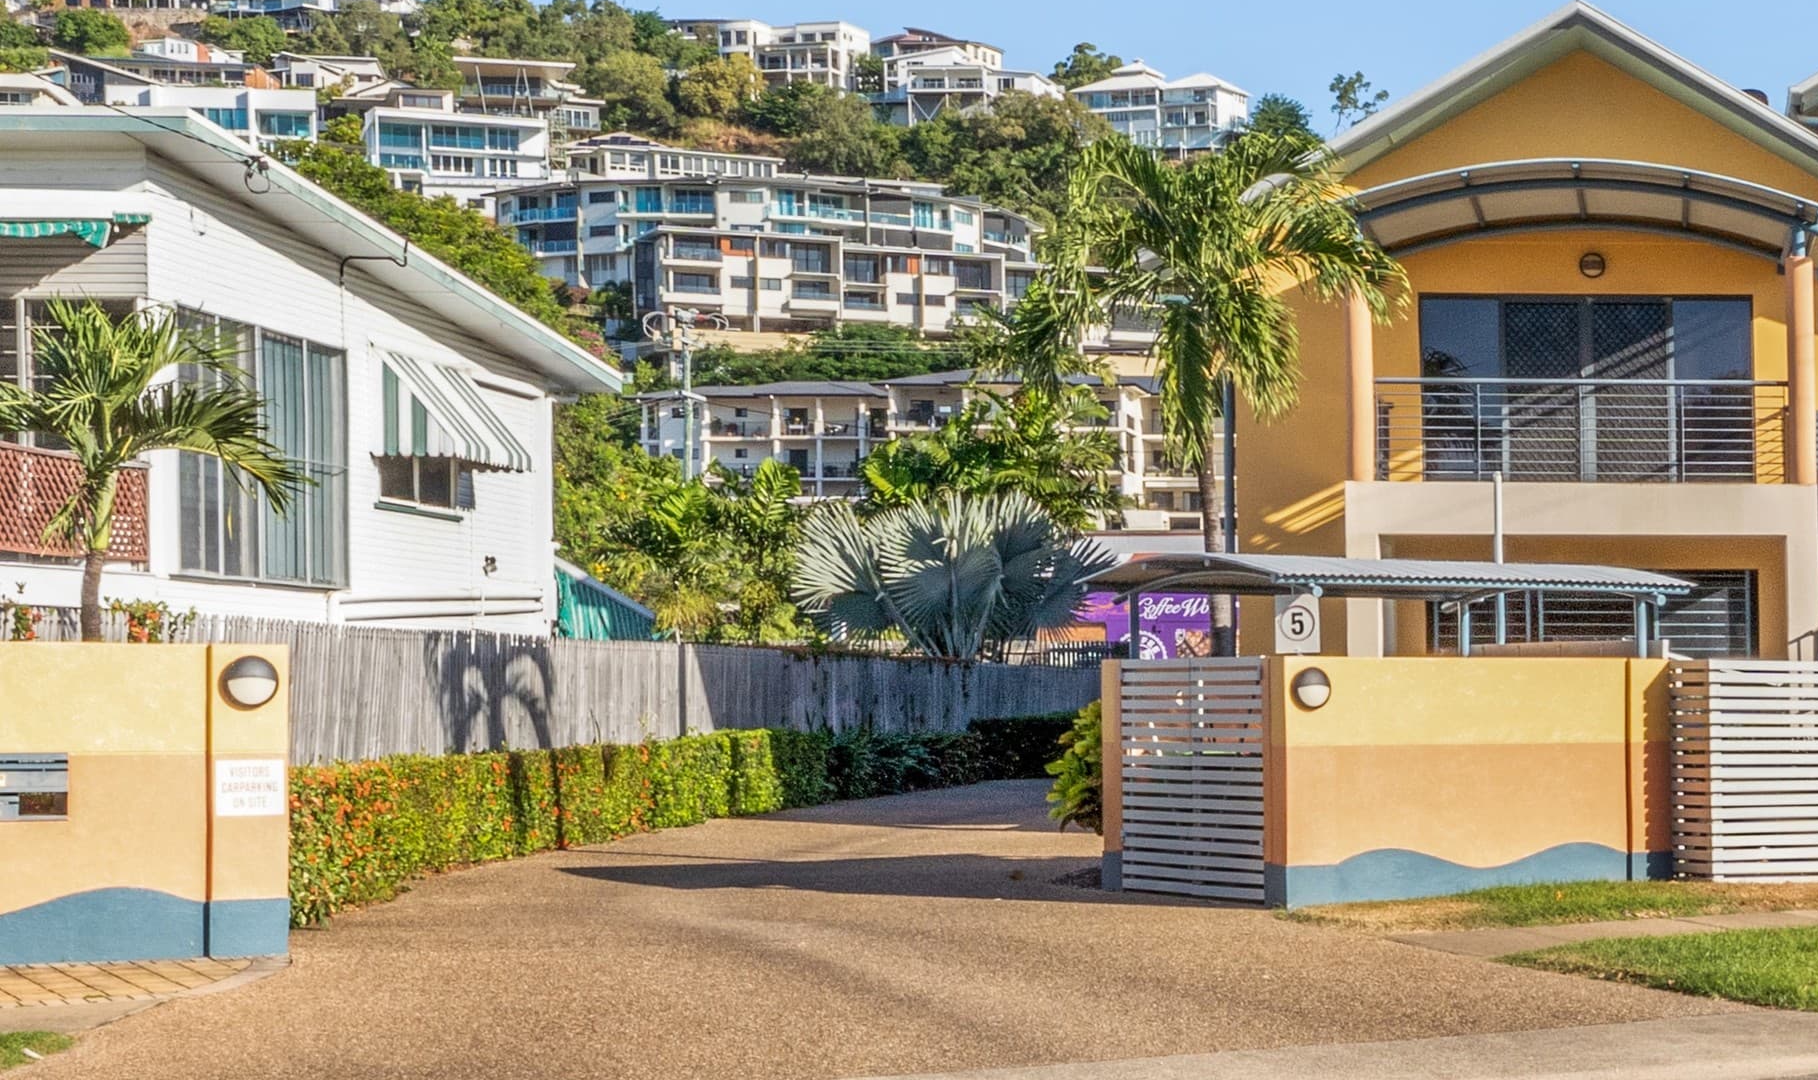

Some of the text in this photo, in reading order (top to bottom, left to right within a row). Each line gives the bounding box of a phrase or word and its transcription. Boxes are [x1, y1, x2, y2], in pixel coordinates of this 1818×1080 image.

[1139, 597, 1210, 620] Coffee Wo
[1291, 612, 1304, 636] 5
